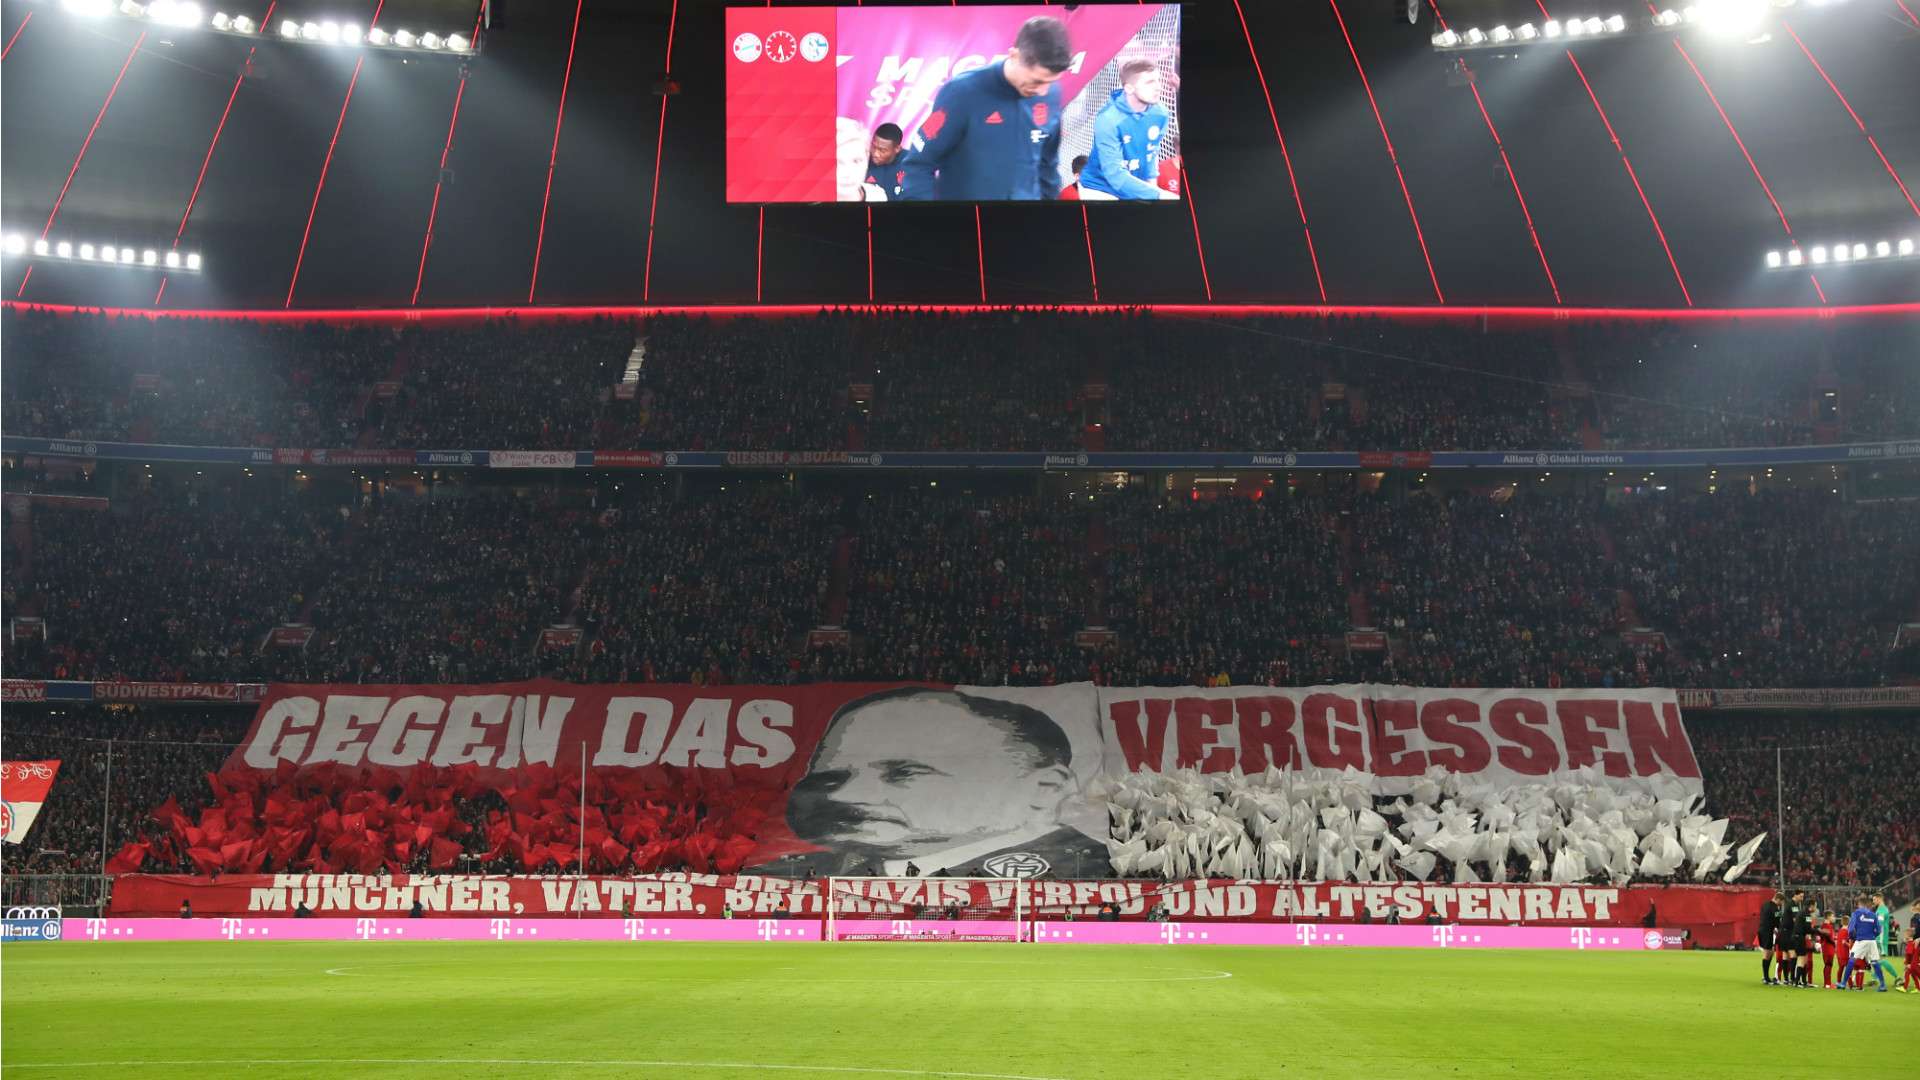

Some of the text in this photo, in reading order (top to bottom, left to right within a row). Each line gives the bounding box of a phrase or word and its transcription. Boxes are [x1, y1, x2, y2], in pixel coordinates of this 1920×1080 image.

[50, 442, 82, 454] Allianz
[1849, 446, 1882, 457] Allianz
[252, 451, 272, 461] Allia
[429, 453, 459, 463] Allianz
[727, 452, 784, 464] GIESSEN
[1045, 455, 1075, 464] Allianz
[1252, 455, 1283, 465] Allianz
[1504, 455, 1623, 464] Allianz Global Investors
[95, 683, 235, 699] SÜDWESTPFALZ
[243, 695, 796, 770] GEGEN DAS
[1110, 693, 1701, 778] VERGESSEN
[541, 879, 707, 915] VATER,
